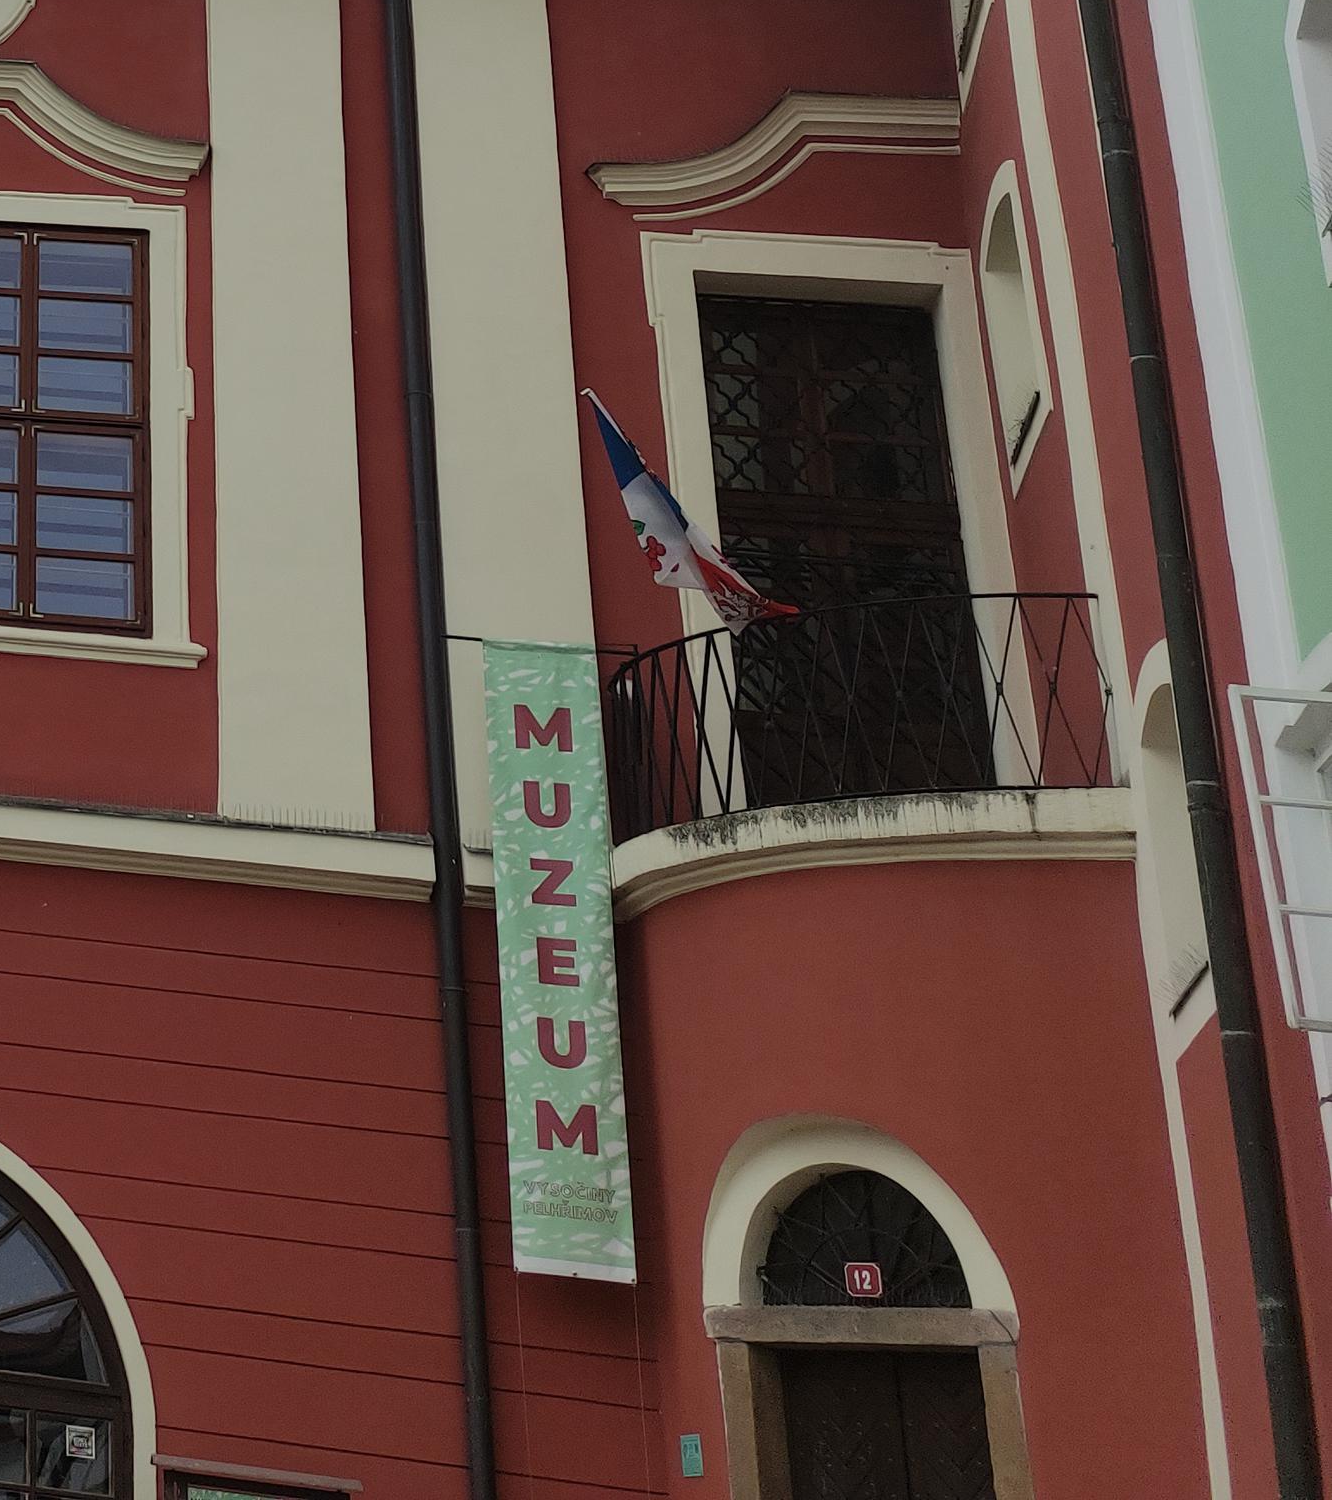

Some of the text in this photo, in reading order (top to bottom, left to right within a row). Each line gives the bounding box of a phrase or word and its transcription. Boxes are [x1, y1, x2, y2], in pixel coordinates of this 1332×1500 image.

[513, 703, 599, 1156] MUZEUM
[522, 1179, 616, 1205] VYSOČINY
[522, 1199, 618, 1224] PELHŘIMOV
[853, 1269, 872, 1290] 12
